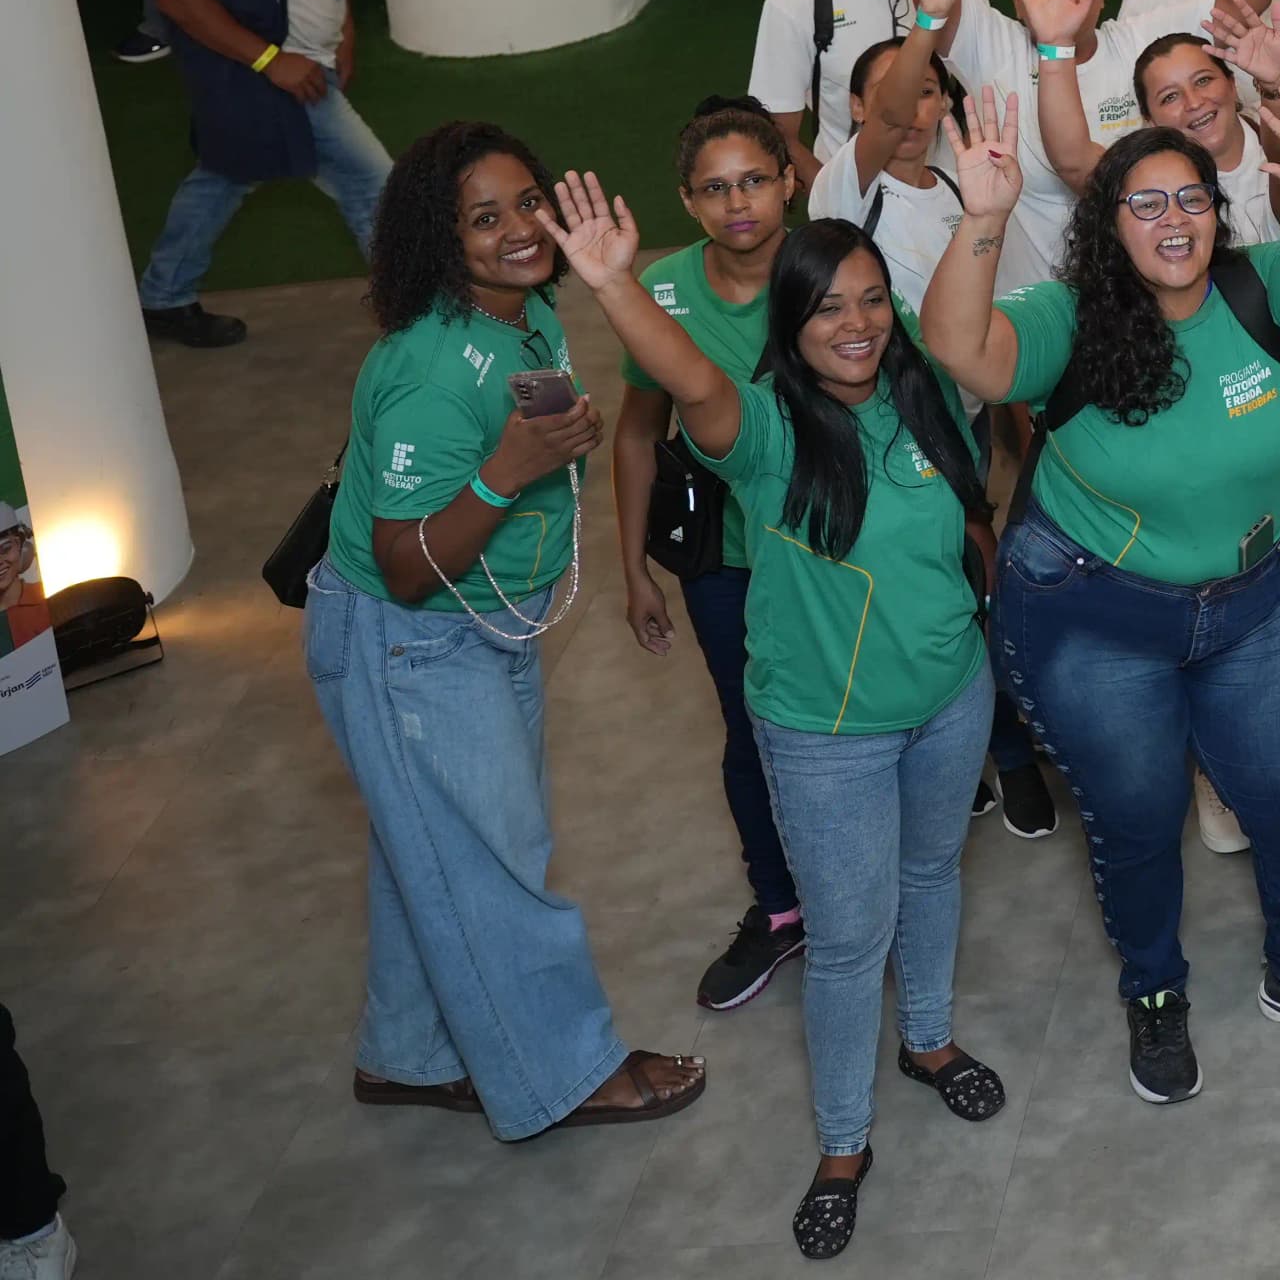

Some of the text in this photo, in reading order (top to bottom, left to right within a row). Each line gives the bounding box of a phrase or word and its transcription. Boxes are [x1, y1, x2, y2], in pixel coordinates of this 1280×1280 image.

[1225, 398, 1233, 409] E
[383, 471, 422, 484] INSTITUTO
[384, 479, 415, 491] FEDERAL
